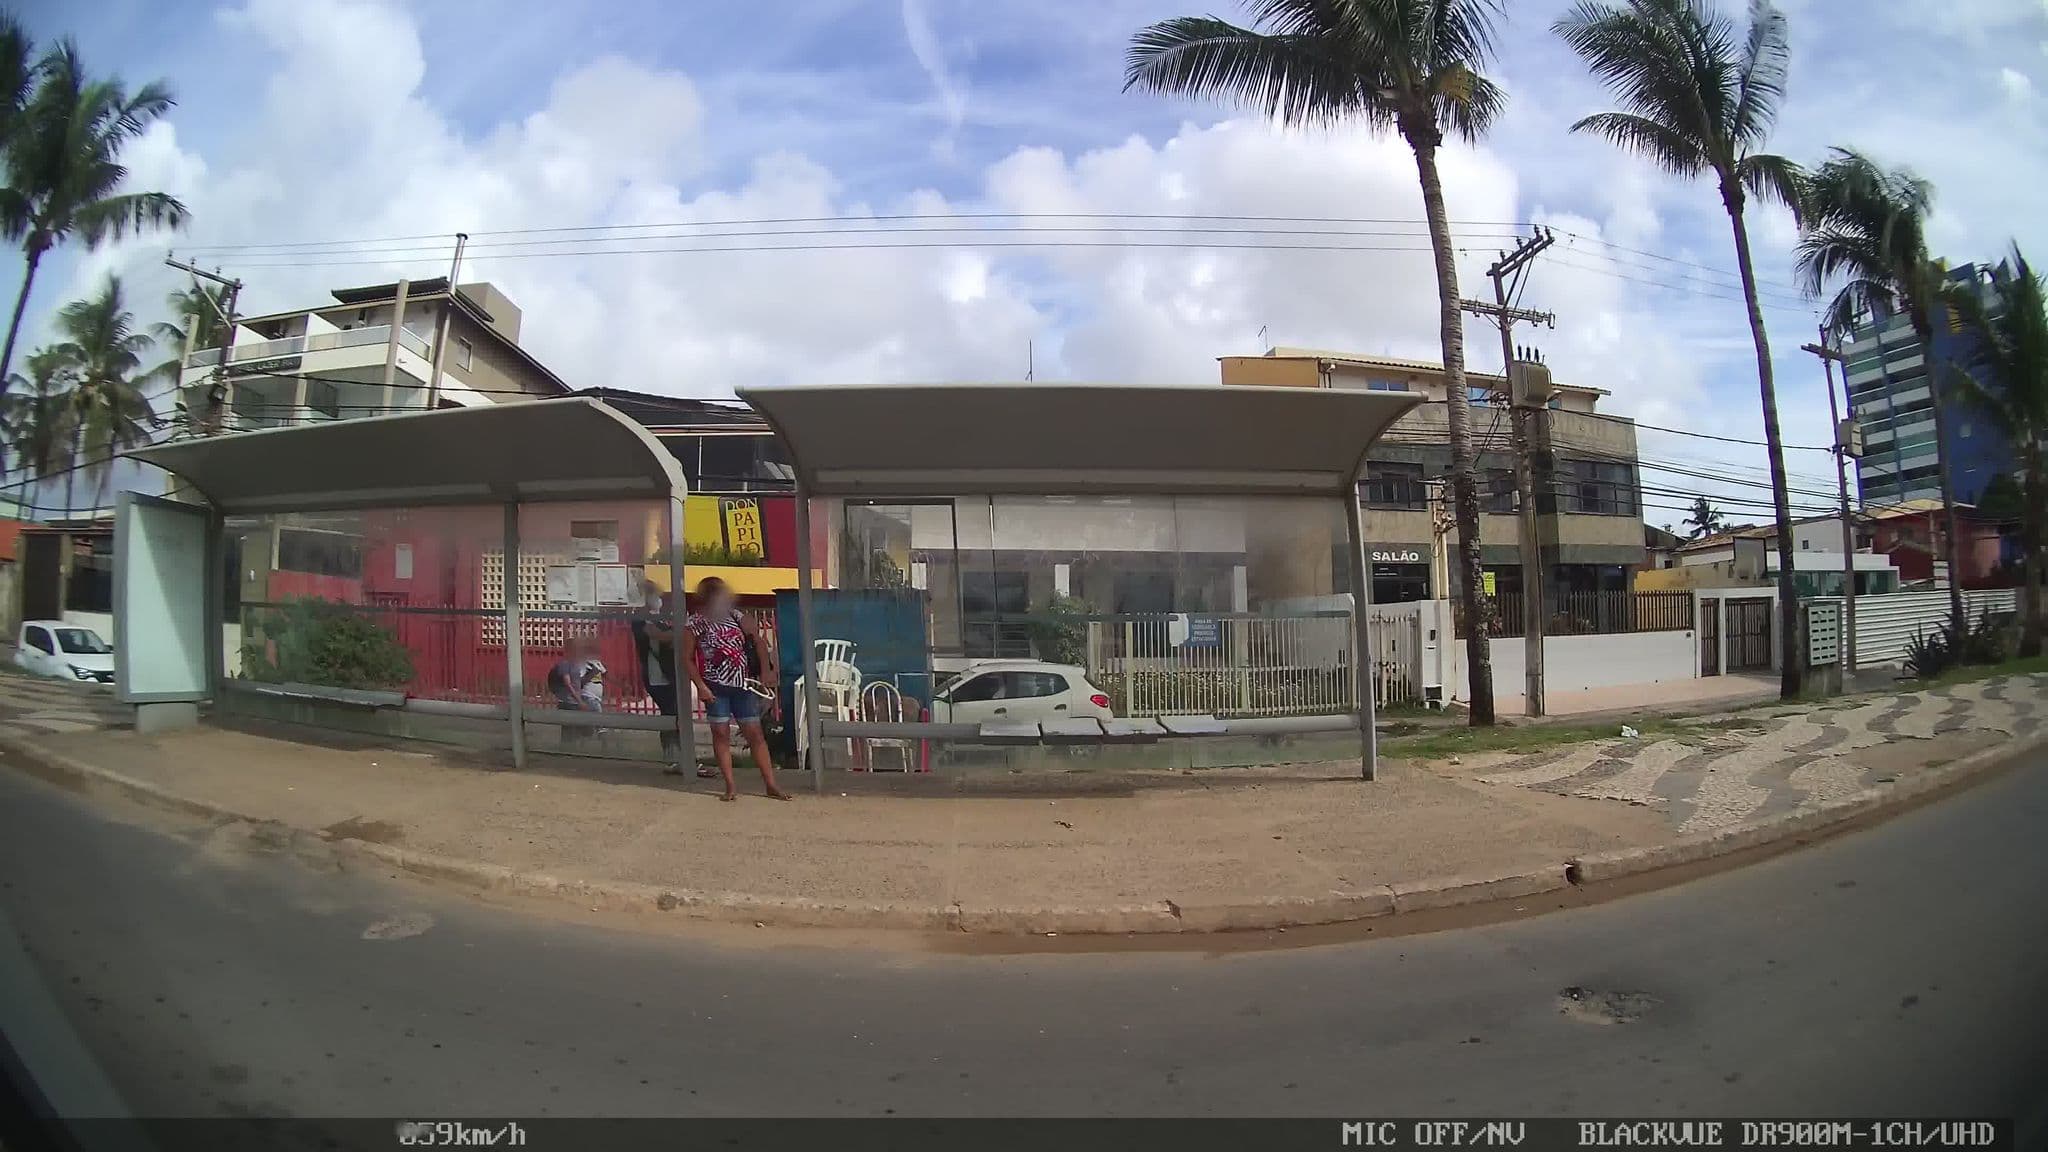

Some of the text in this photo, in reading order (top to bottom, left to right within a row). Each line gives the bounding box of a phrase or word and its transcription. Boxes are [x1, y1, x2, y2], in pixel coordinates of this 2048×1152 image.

[725, 498, 758, 512] DON
[734, 512, 755, 526] PA
[737, 528, 755, 541] PI
[1372, 550, 1419, 561] SALÃO
